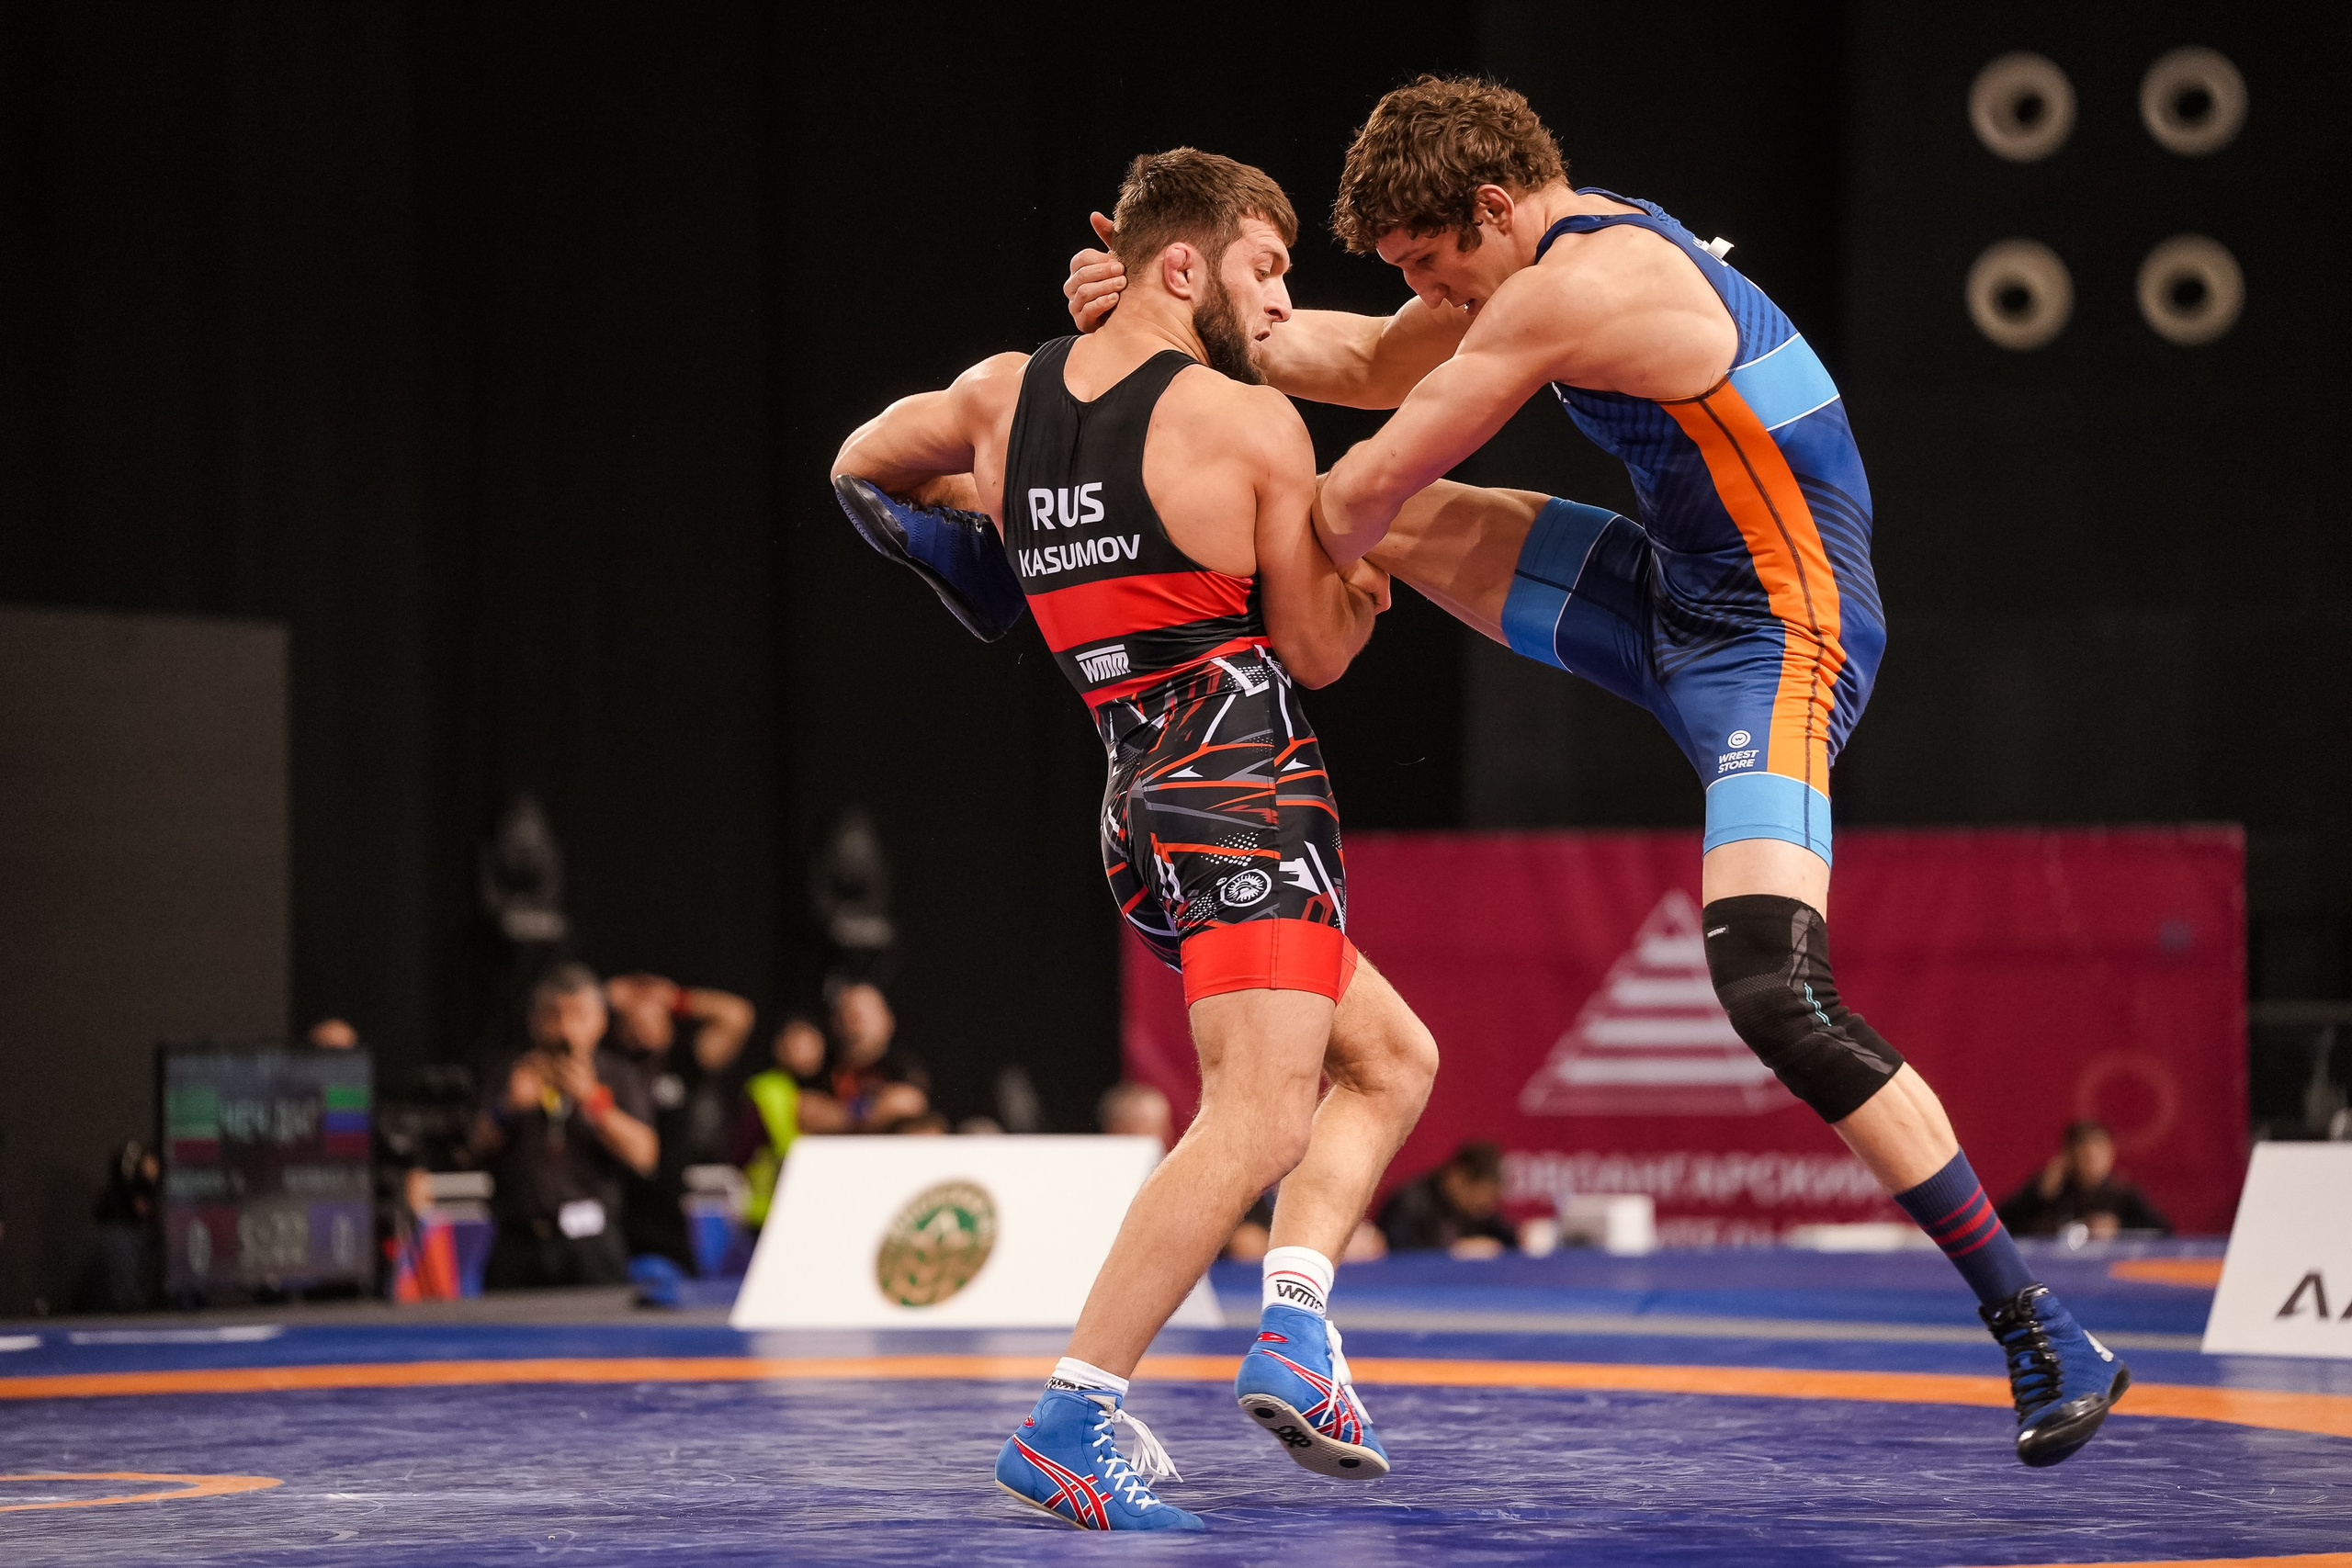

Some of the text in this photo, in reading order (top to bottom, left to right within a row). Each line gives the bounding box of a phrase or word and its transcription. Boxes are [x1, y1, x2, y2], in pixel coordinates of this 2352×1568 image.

[1028, 482, 1104, 531] RUS
[1018, 535, 1140, 578] KASUMOV
[1717, 759, 1756, 773] STORE
[1718, 750, 1759, 764] WREST
